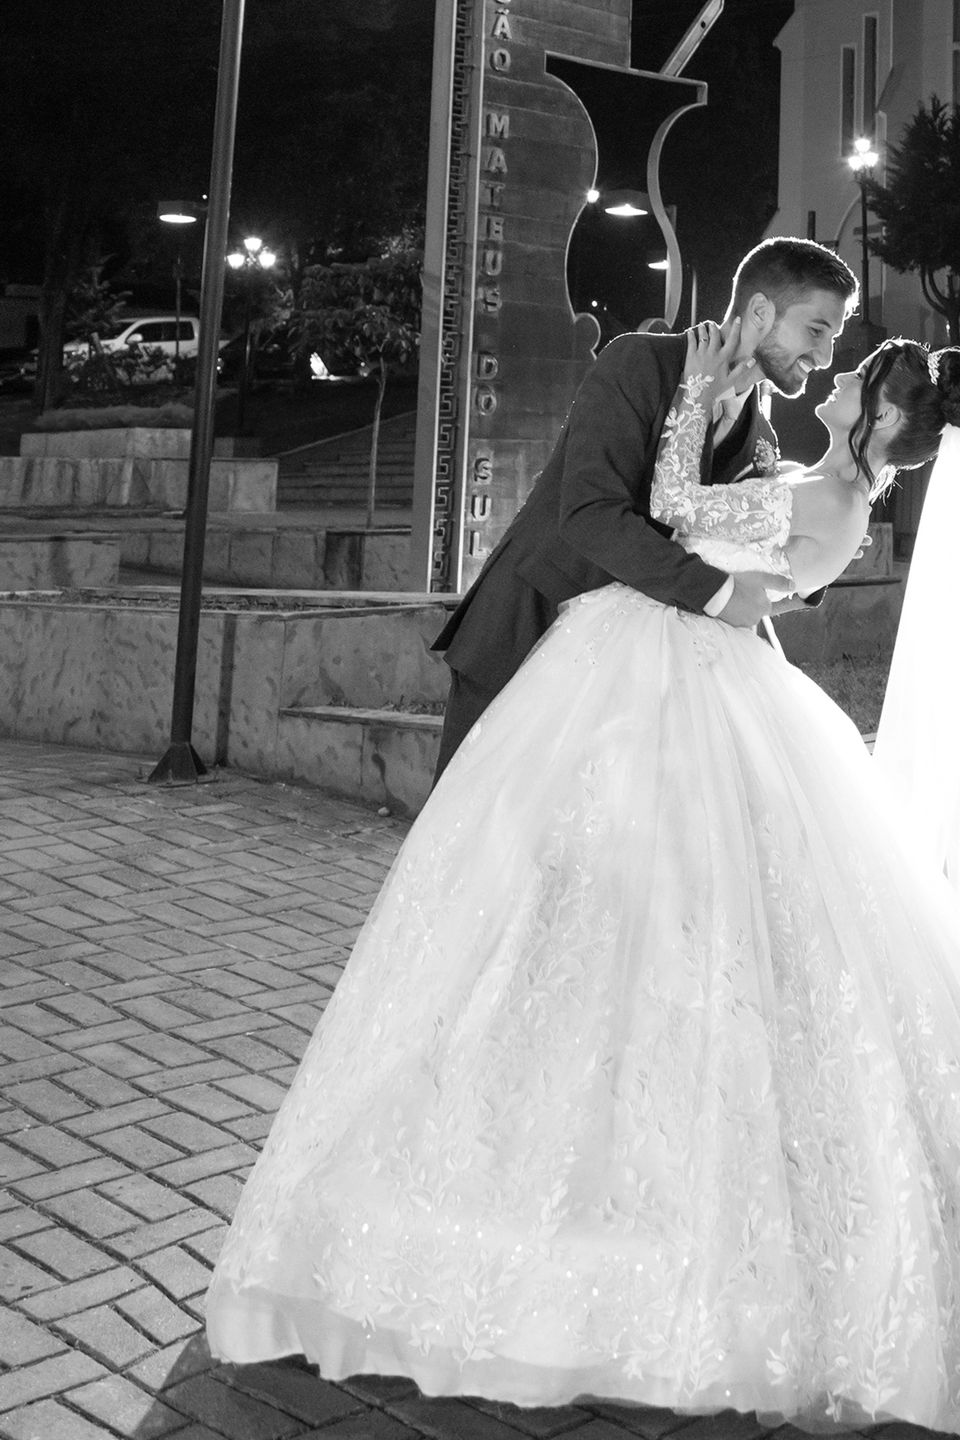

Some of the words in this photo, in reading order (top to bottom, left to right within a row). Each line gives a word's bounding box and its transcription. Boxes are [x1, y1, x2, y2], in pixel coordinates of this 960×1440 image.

[482, 112, 510, 313] MATEUS
[476, 351, 499, 416] DO
[470, 458, 493, 558] SUL
